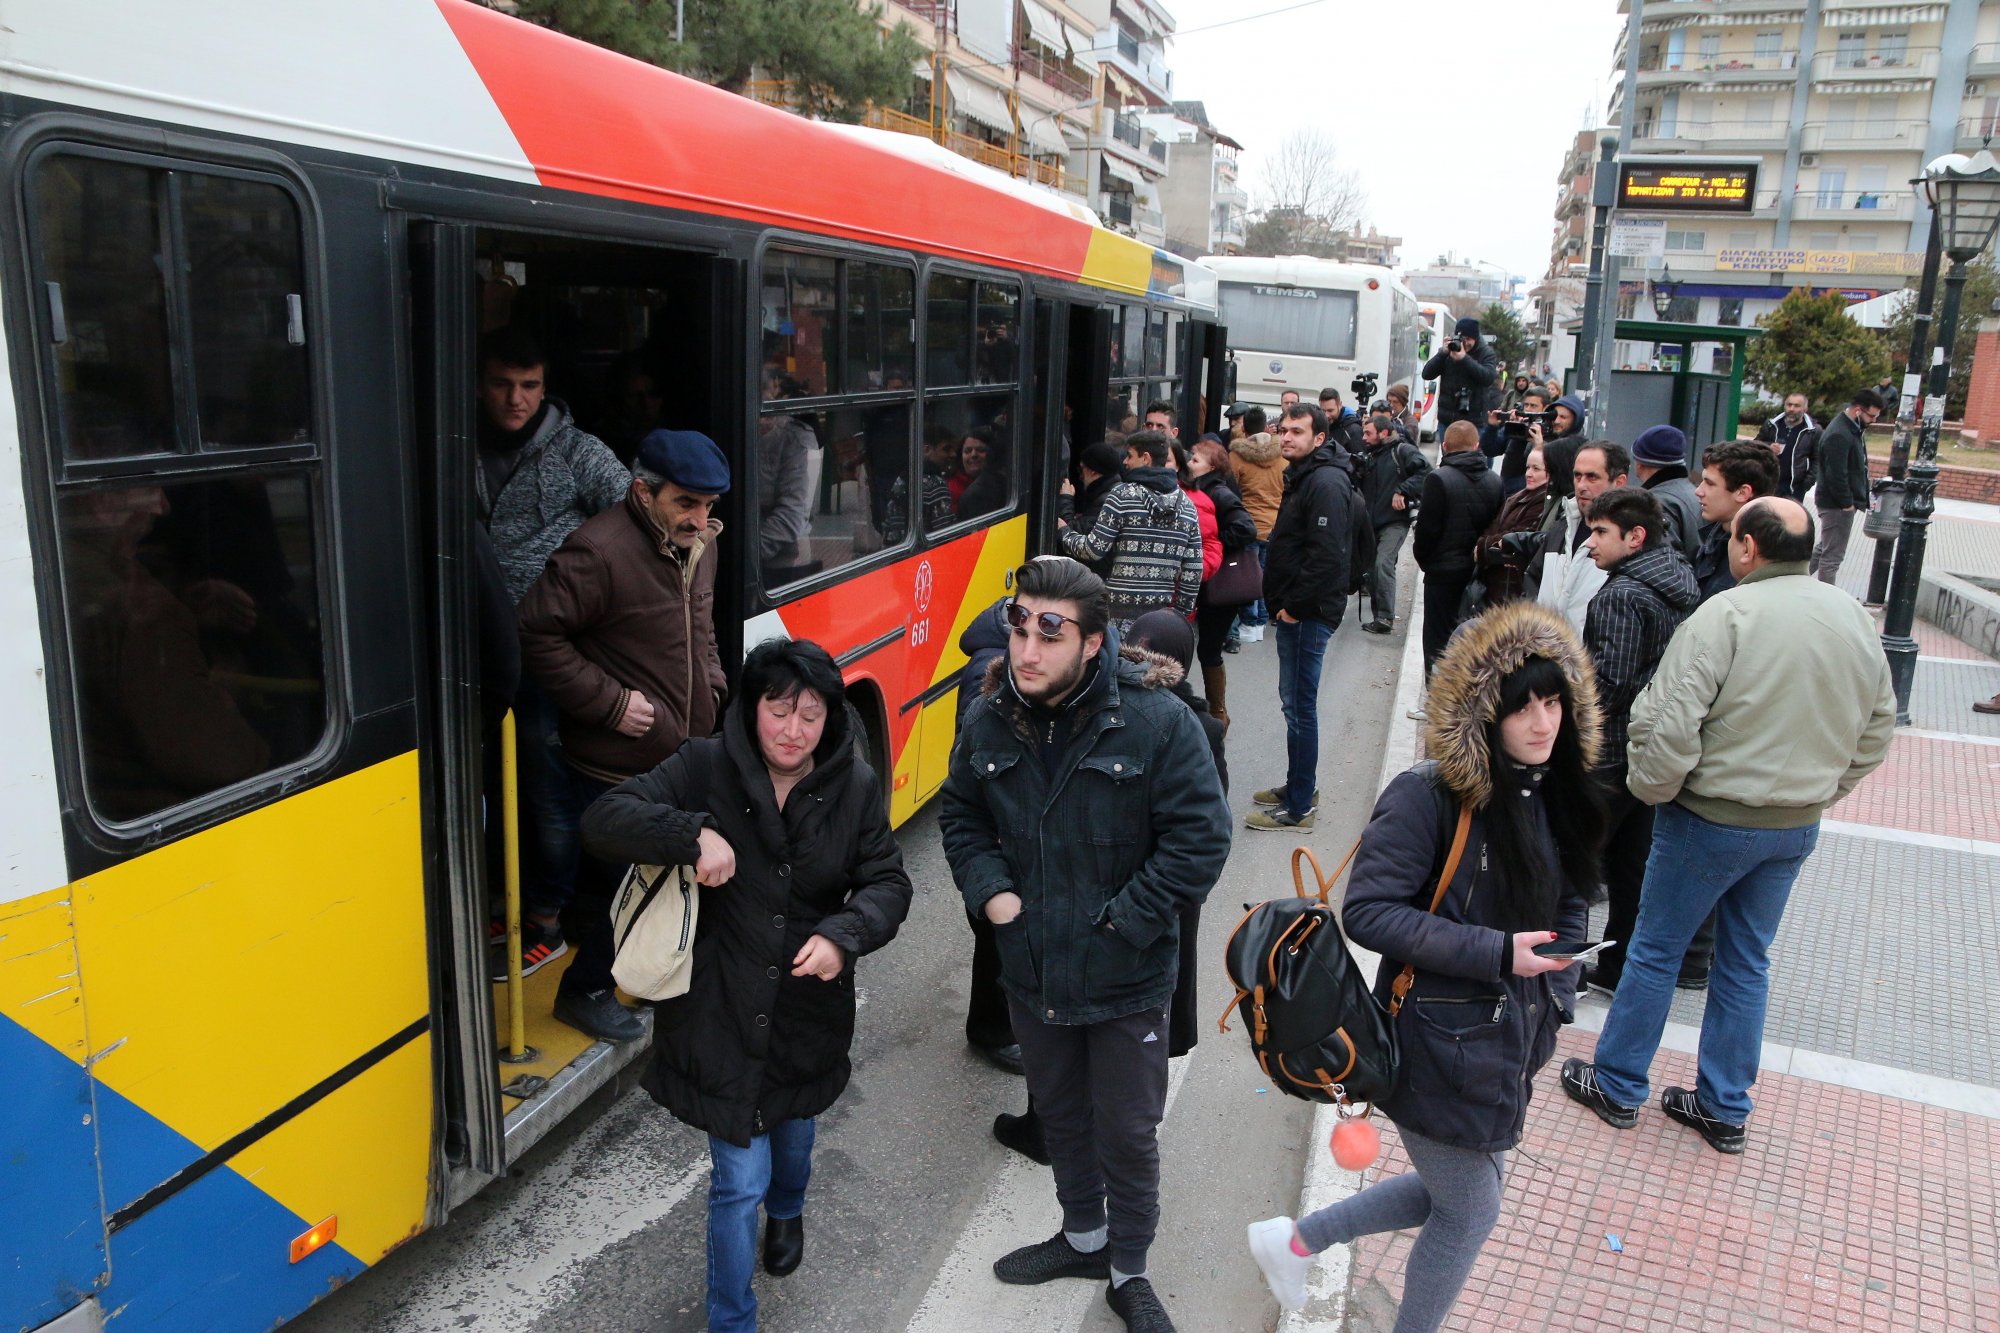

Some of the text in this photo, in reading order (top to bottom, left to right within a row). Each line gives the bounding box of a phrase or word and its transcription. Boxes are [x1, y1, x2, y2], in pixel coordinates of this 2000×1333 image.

[1720, 249, 1806, 258] ΔΙΑΓΝΩΣΤΙΚΟ
[1719, 256, 1805, 265] ΘΕΡΑΠΕΥΤΙΚΟ
[1732, 263, 1789, 271] ΚΕΝΤΡΟ
[1253, 285, 1318, 299] TEMSA
[911, 617, 929, 647] 661
